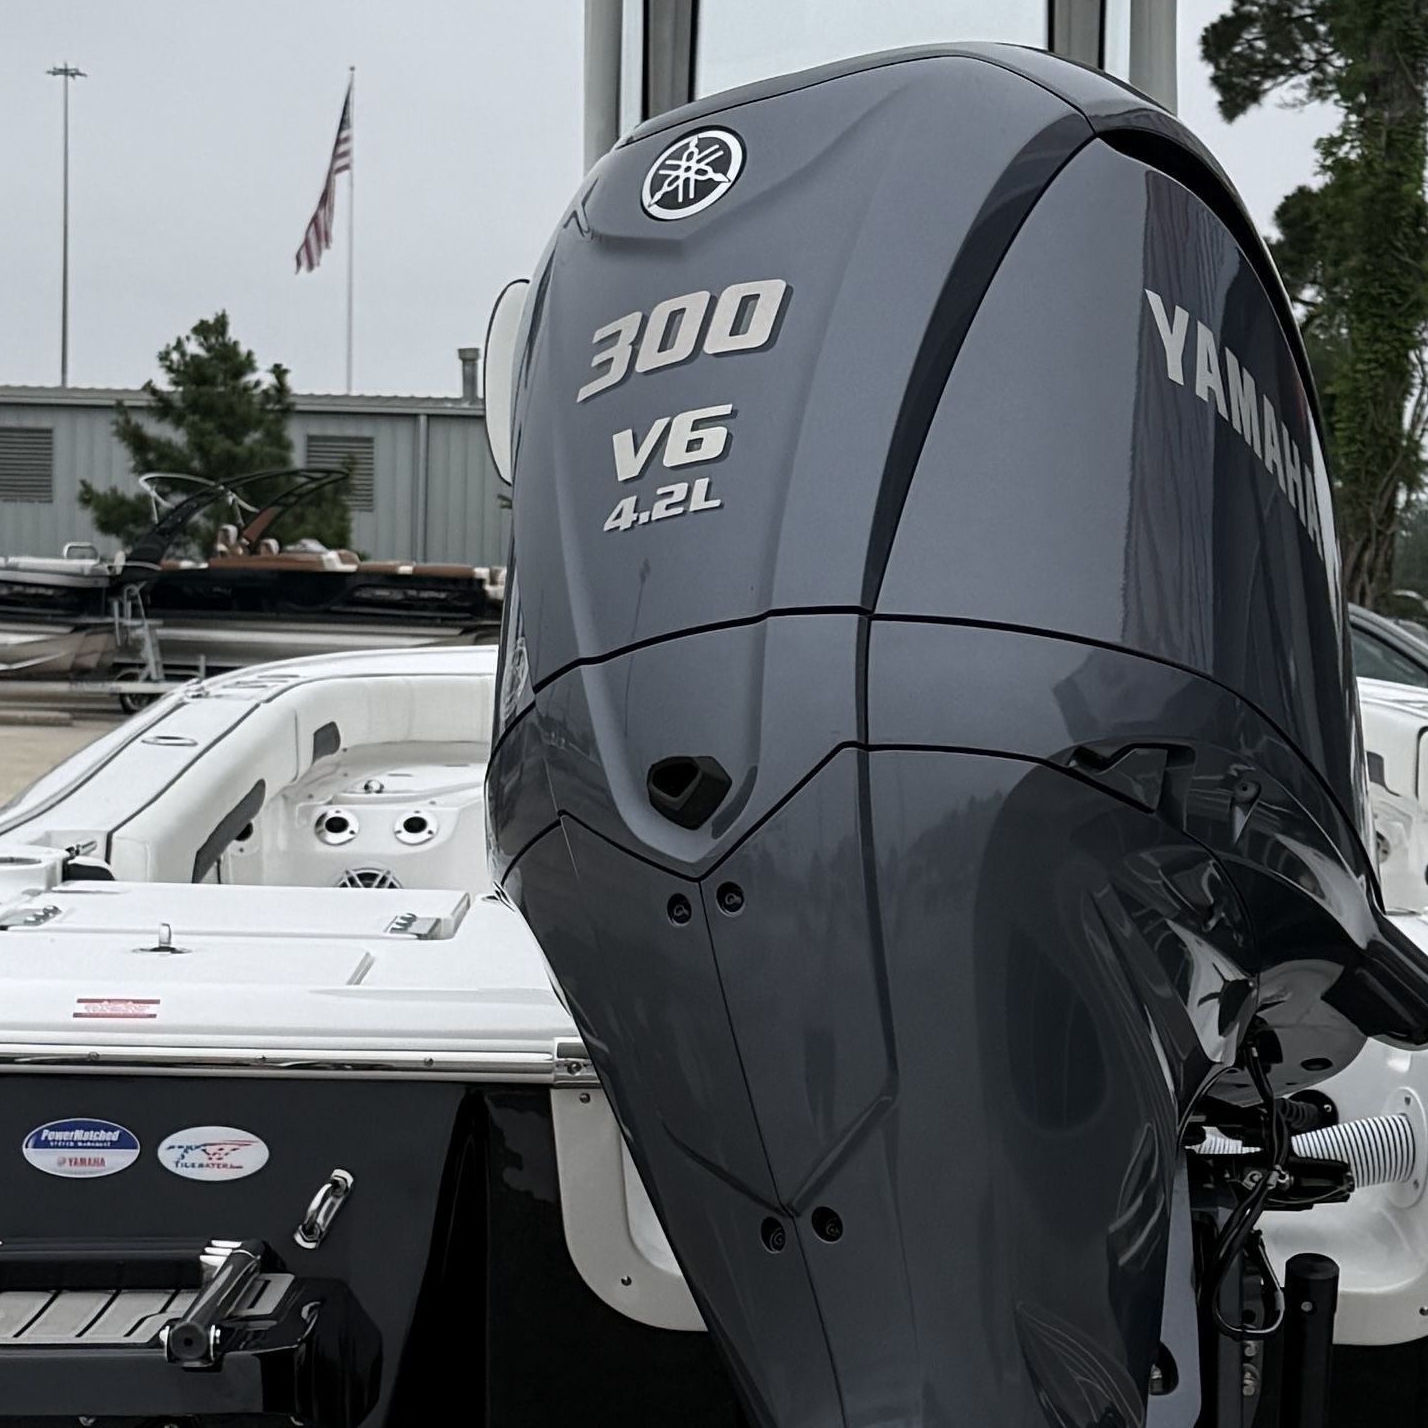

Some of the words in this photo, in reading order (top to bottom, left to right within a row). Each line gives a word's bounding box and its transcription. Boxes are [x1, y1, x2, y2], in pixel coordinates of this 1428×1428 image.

[576, 278, 793, 404] 300
[612, 403, 738, 483] V6
[1144, 288, 1324, 562] YAMAHA
[603, 477, 723, 532] 4.2L
[69, 1157, 106, 1167] YAMAHA
